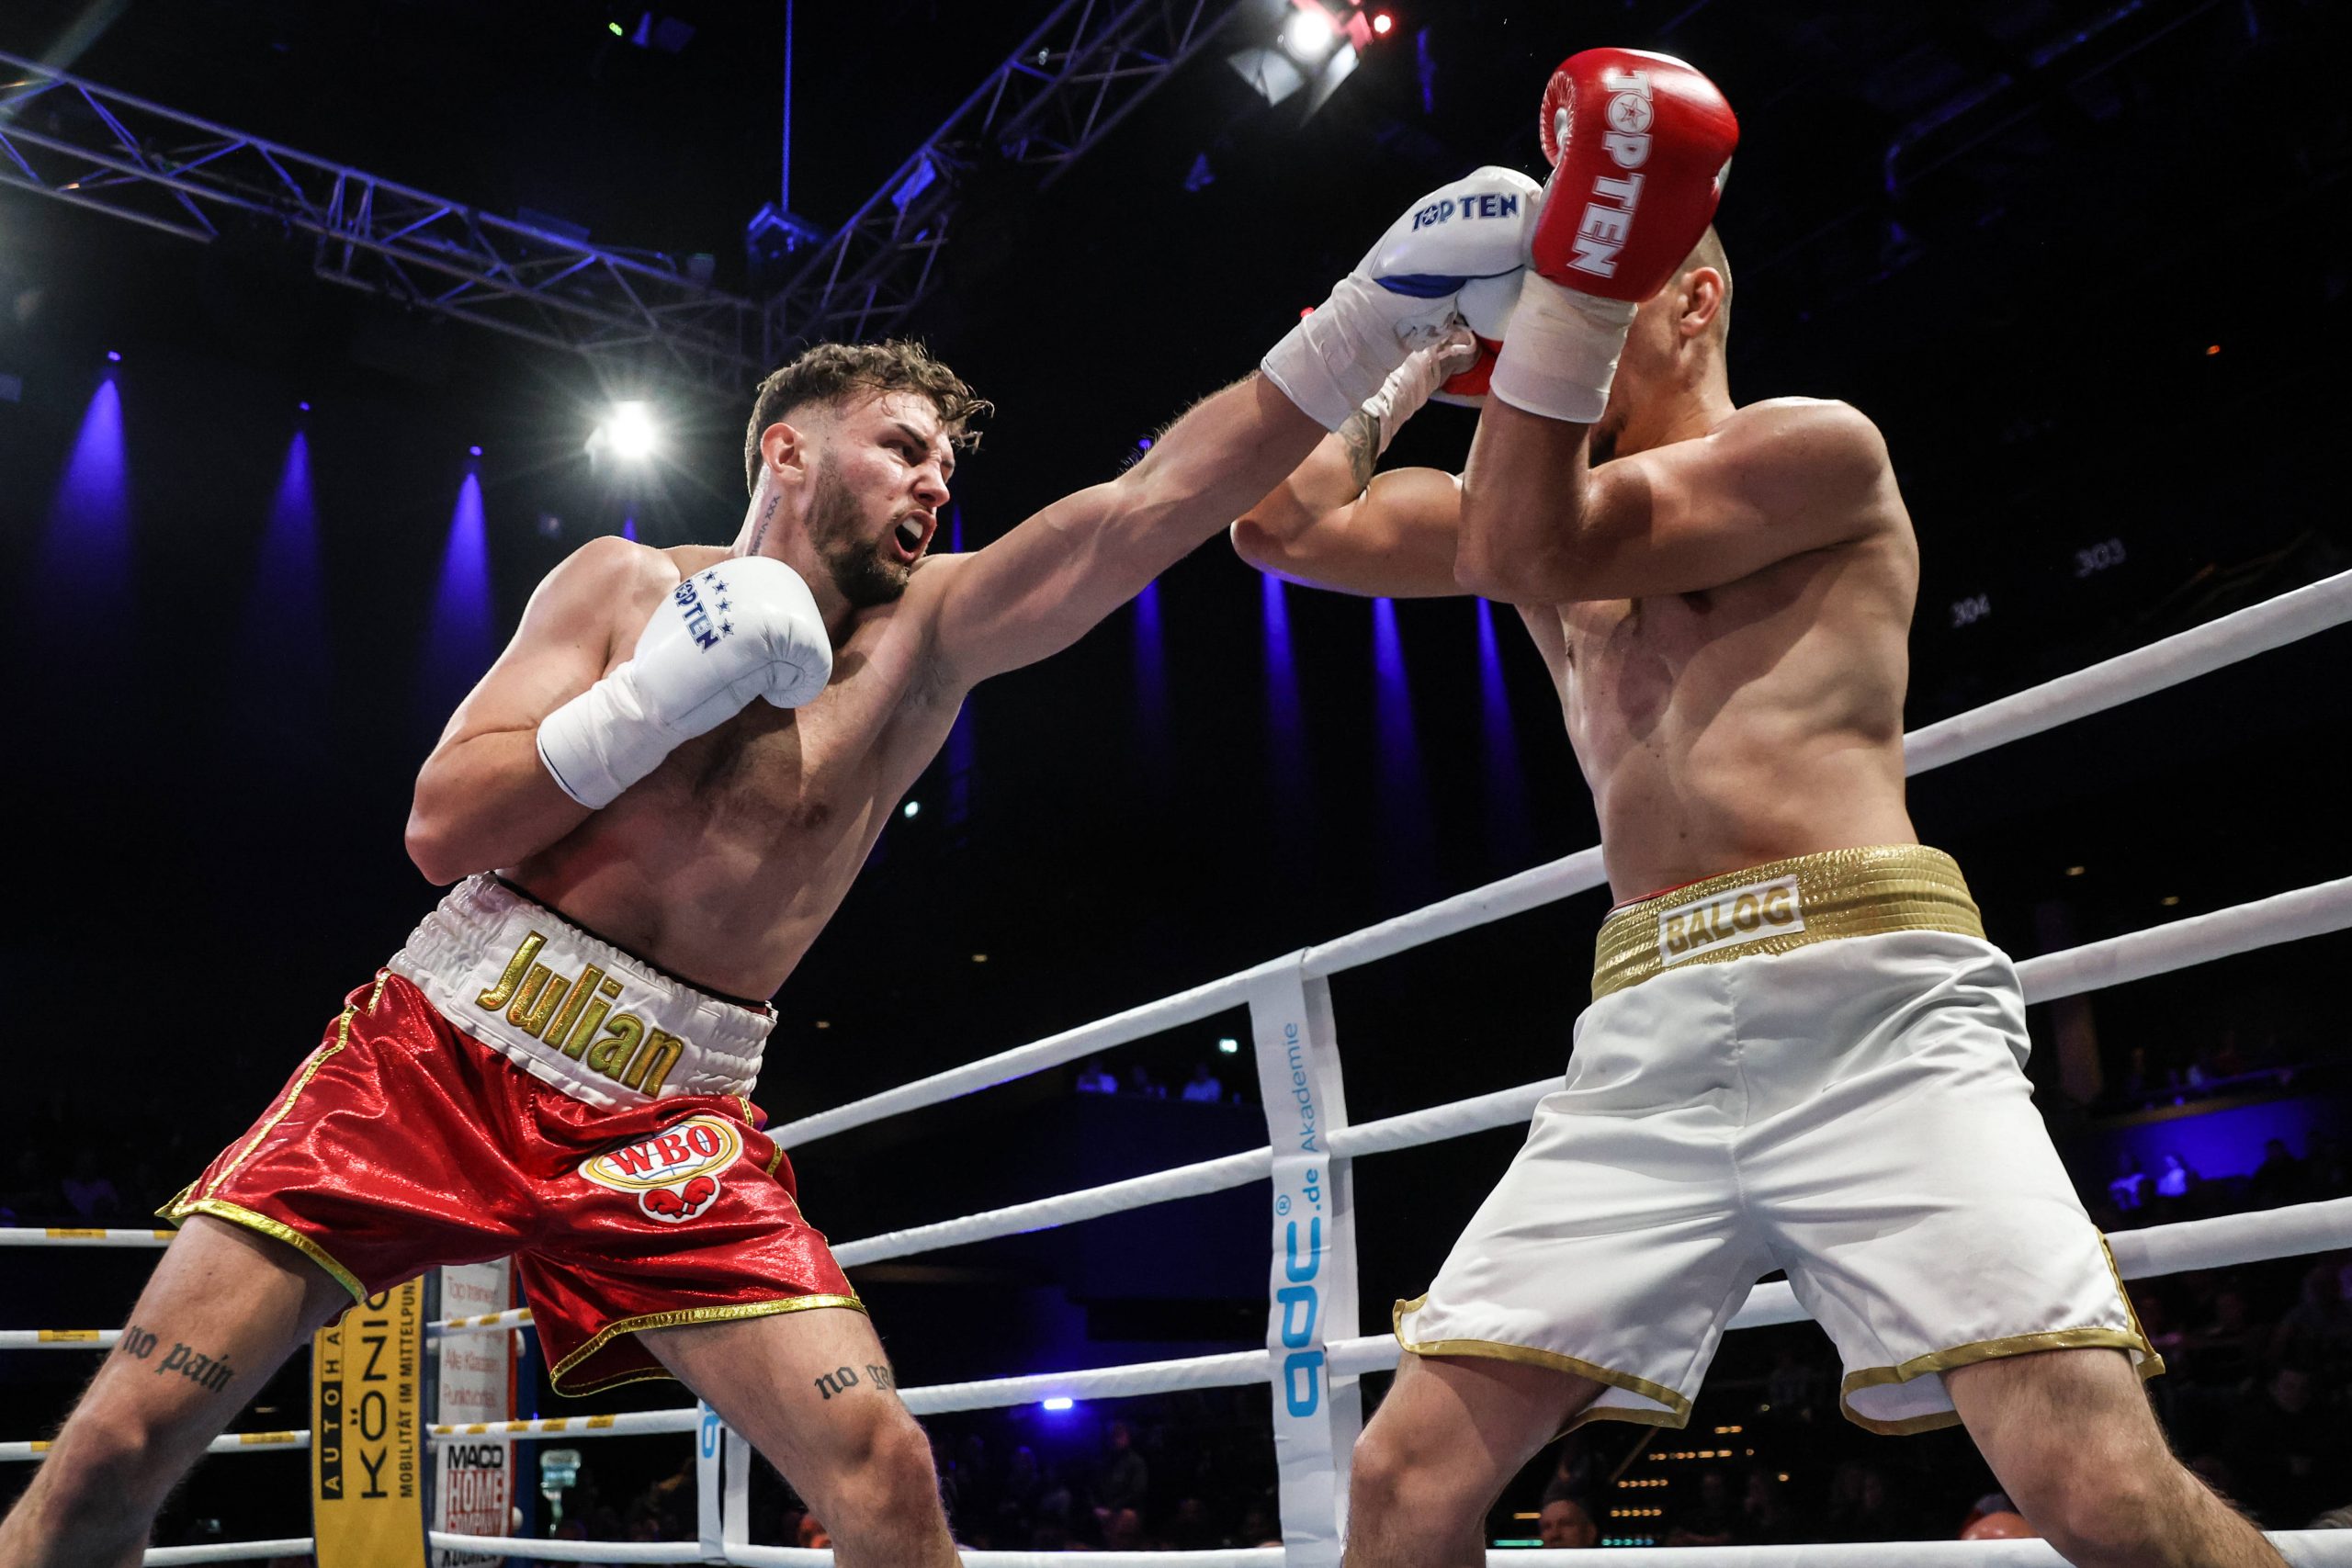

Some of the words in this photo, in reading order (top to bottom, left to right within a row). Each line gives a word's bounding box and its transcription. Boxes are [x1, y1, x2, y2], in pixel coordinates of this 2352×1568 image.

[1602, 70, 1654, 168] TOP
[1412, 198, 1455, 231] TOP
[1458, 193, 1520, 220] TEN
[1566, 173, 1645, 278] TEN
[682, 600, 721, 654] TEN
[1667, 886, 1794, 956] BALOG
[475, 930, 685, 1099] Julian
[1284, 1022, 1320, 1153] Akademie
[606, 1125, 720, 1176] WBO
[123, 1325, 159, 1359] no
[154, 1343, 234, 1393] pain
[814, 1366, 860, 1400] no
[400, 1386, 413, 1404] IM
[398, 1408, 413, 1498] MOBILITÄT
[448, 1471, 503, 1512] HOME
